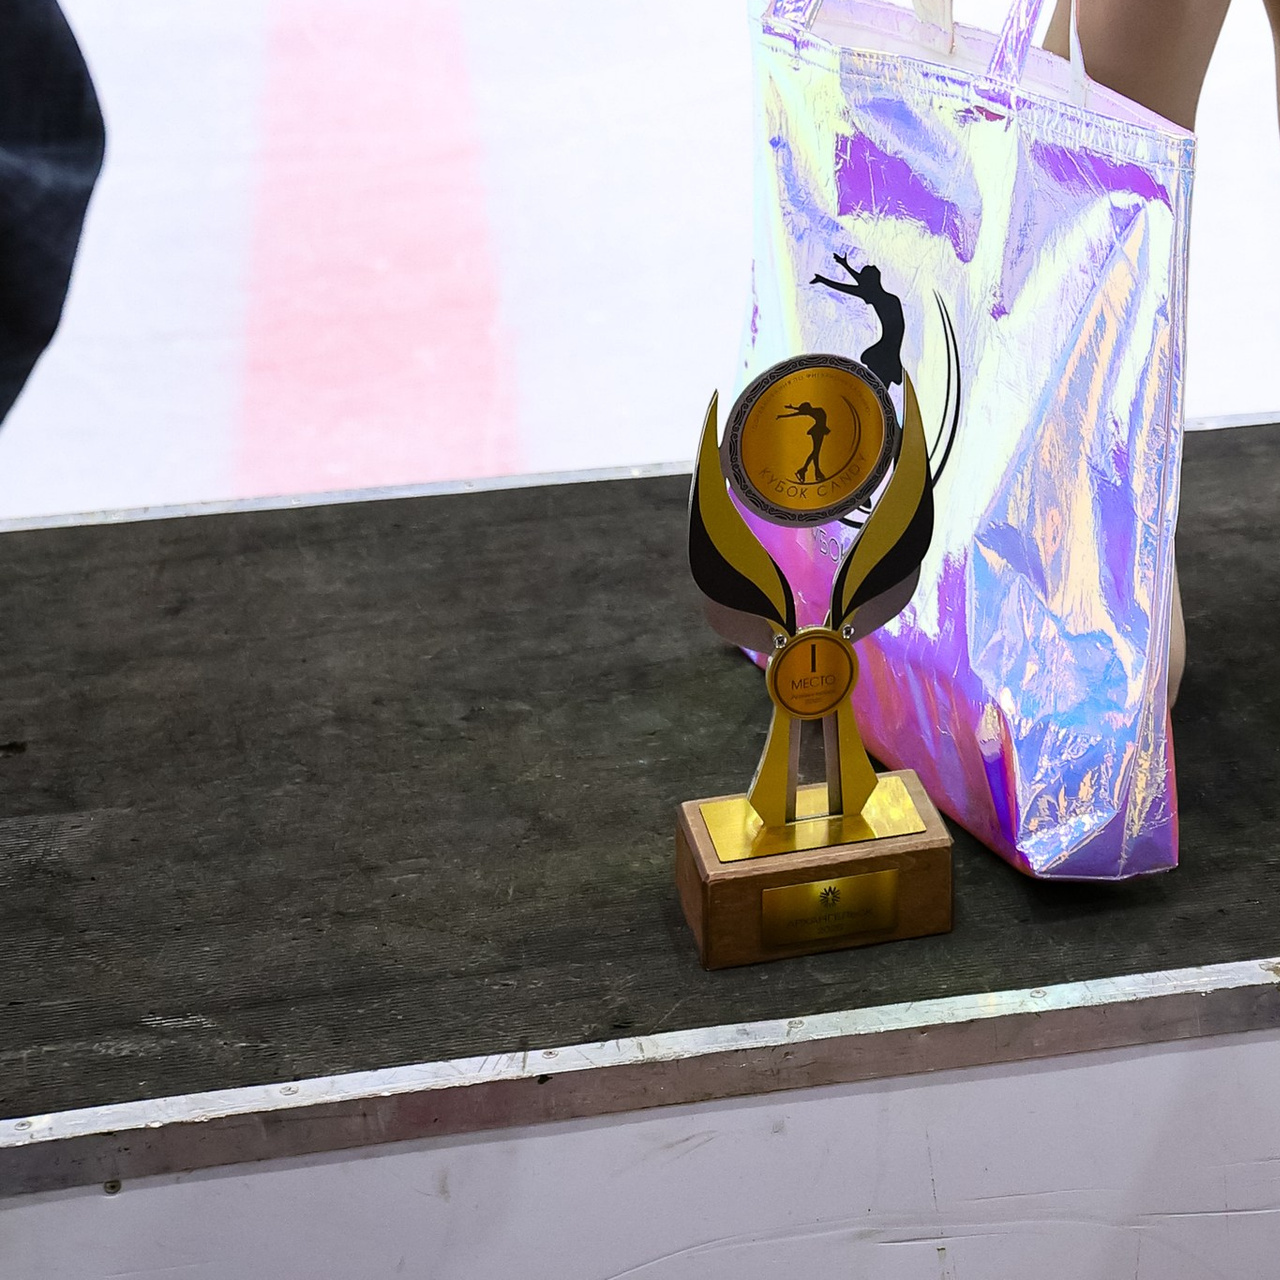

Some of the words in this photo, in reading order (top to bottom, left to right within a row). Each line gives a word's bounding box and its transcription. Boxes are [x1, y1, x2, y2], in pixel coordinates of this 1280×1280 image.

[758, 467, 808, 499] КУБОК
[817, 452, 868, 497] CANDY
[791, 674, 836, 690] МЕСТО
